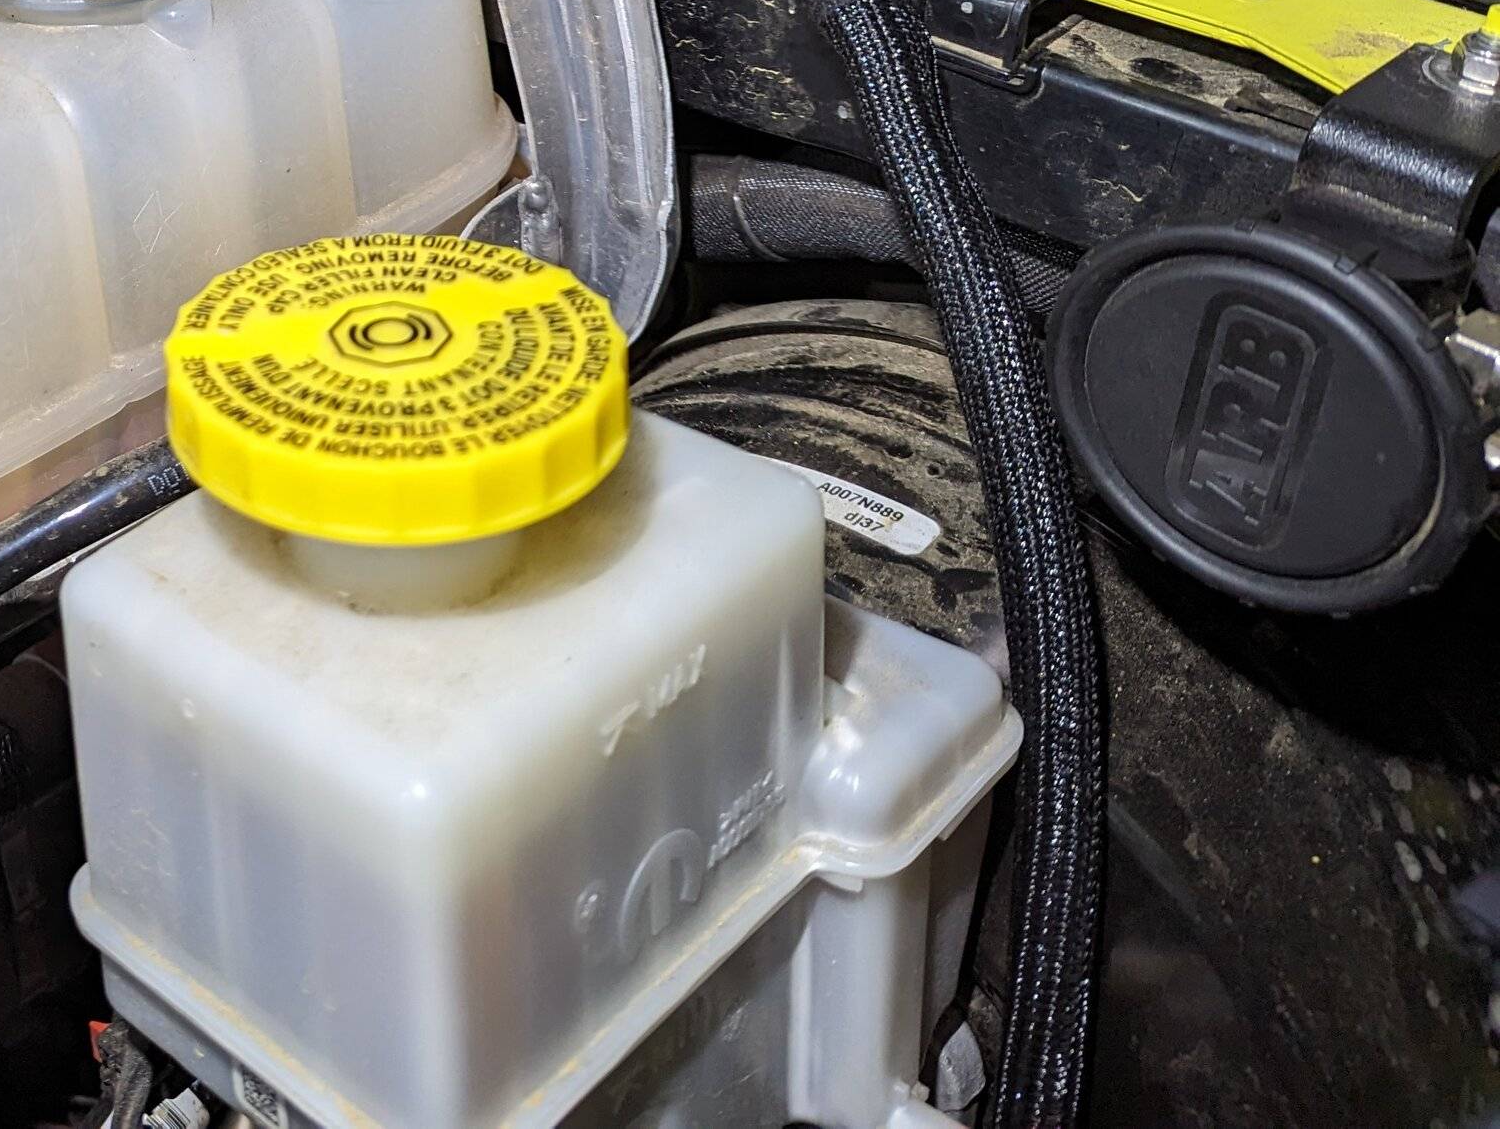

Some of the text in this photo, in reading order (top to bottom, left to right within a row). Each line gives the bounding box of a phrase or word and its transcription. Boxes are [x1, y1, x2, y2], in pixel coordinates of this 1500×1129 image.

[332, 238, 346, 250] A
[353, 233, 416, 248] FROM
[420, 235, 484, 255] FLUID
[483, 246, 500, 259] 3
[252, 240, 328, 271] SEALED
[428, 252, 513, 282] BEFORE
[501, 252, 546, 276] DOT
[247, 272, 289, 298] USE
[266, 266, 457, 314] CLEAN FILLER CAP
[557, 284, 600, 314] MISE
[218, 296, 256, 330] ONLY
[504, 306, 535, 325] DU
[535, 302, 575, 343] AVANT
[581, 315, 609, 334] EN
[404, 320, 505, 396] CONTENANT
[495, 325, 539, 381] LIQUIDE
[547, 342, 576, 363] DE
[535, 363, 567, 383] LE
[180, 354, 278, 436] REMPLISSAGE
[217, 360, 331, 430] UNIQUEMENT
[282, 381, 435, 417] PROVENANT
[438, 395, 457, 414] 3
[460, 376, 507, 408] DOT
[334, 419, 451, 439] UTILISER
[1189, 320, 1304, 526] ARB
[278, 428, 312, 449] DE
[315, 436, 446, 461] BOUCHON
[451, 433, 485, 453] LE
[816, 482, 905, 522] A007N889
